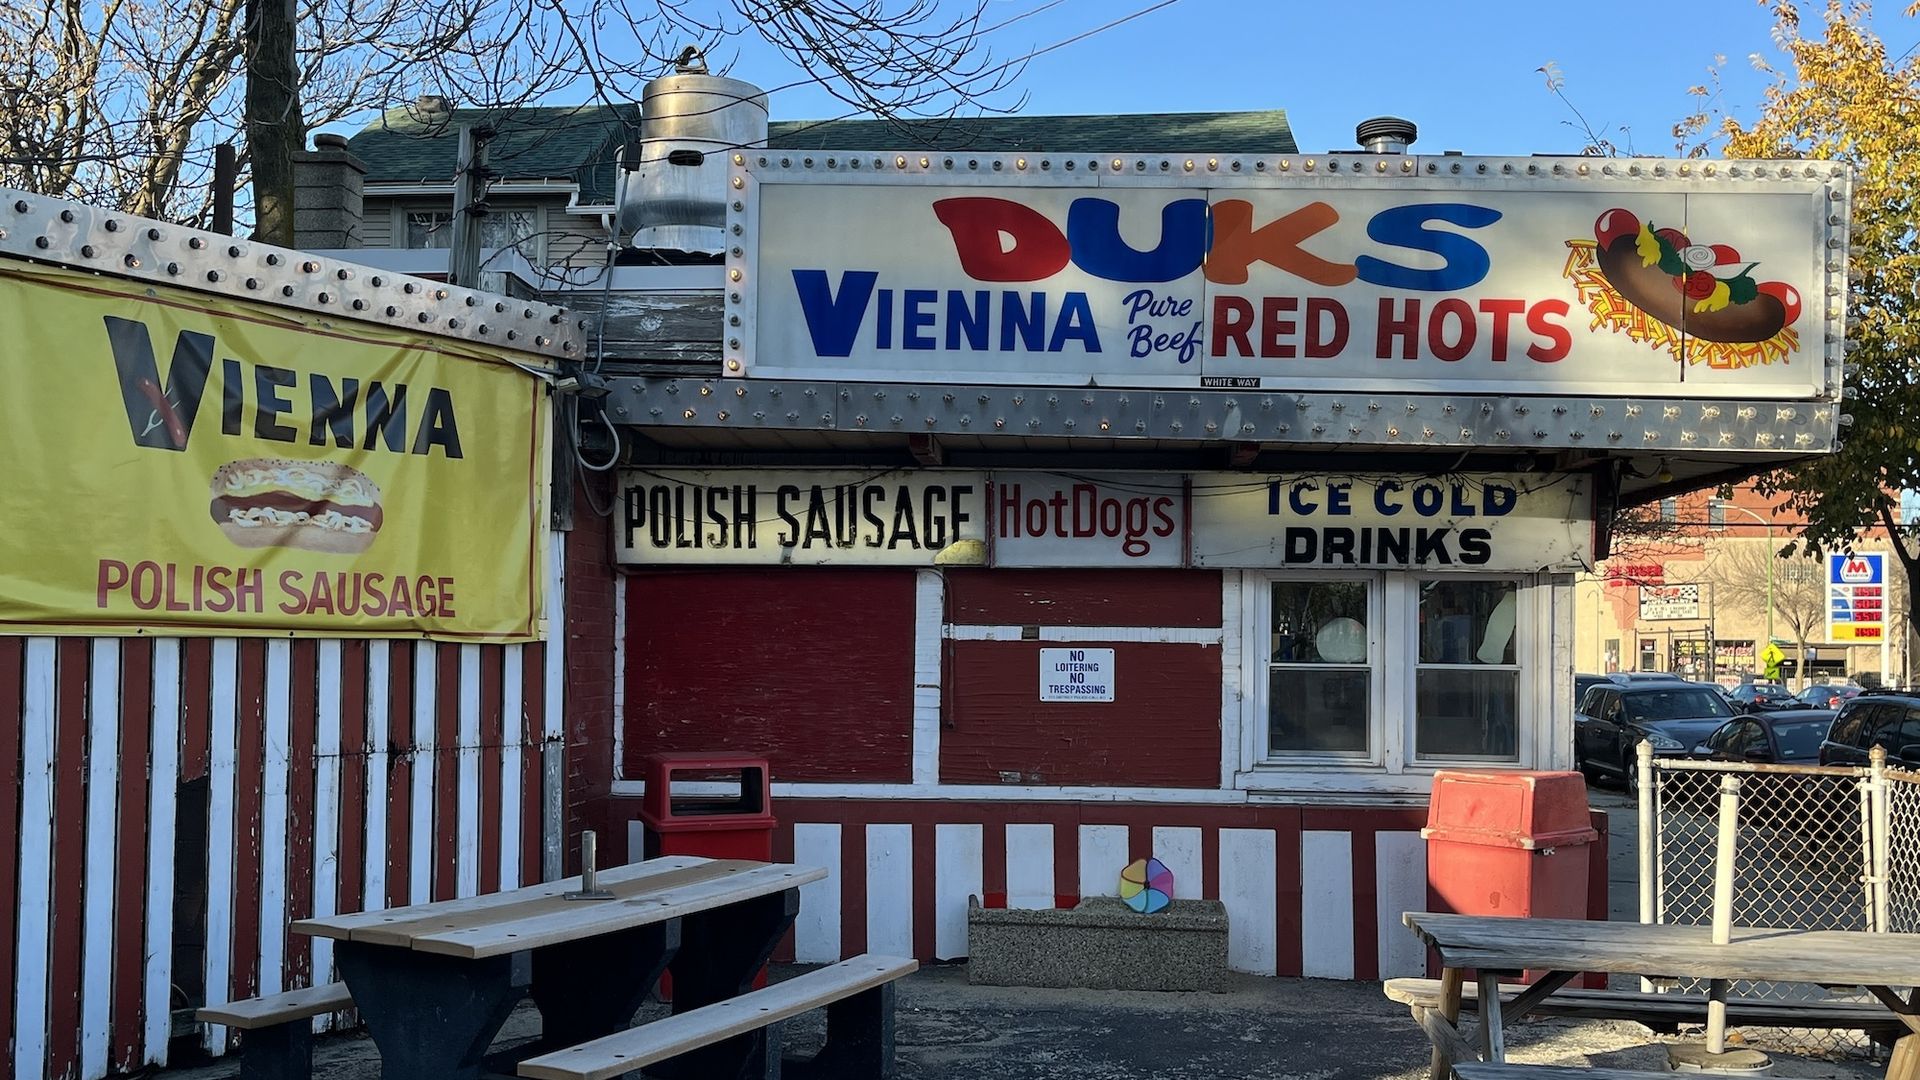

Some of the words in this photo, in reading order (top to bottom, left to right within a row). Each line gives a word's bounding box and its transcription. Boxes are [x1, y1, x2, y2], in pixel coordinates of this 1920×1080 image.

[932, 197, 1503, 291] DUKS
[791, 270, 1102, 357] VIENNA
[1123, 289, 1193, 324] Pure
[1127, 321, 1204, 364] Beef
[1211, 296, 1350, 360] RED
[1376, 297, 1572, 363] HOTS
[103, 315, 464, 459] VIENNA
[1204, 378, 1233, 387] WHITE
[1237, 378, 1257, 387] WAY
[625, 483, 757, 550] POLISH
[776, 484, 974, 550] SAUSAGE
[1267, 475, 1354, 516] ICE
[1374, 476, 1518, 517] COLD
[1285, 526, 1492, 565] DRINKS
[97, 559, 263, 614] POLISH
[279, 570, 457, 618] SAUSAGE
[1055, 662, 1099, 672] LOITERING
[1069, 650, 1085, 662] NO
[1049, 684, 1106, 694] TRESPASSING
[1069, 672, 1085, 684] NO
